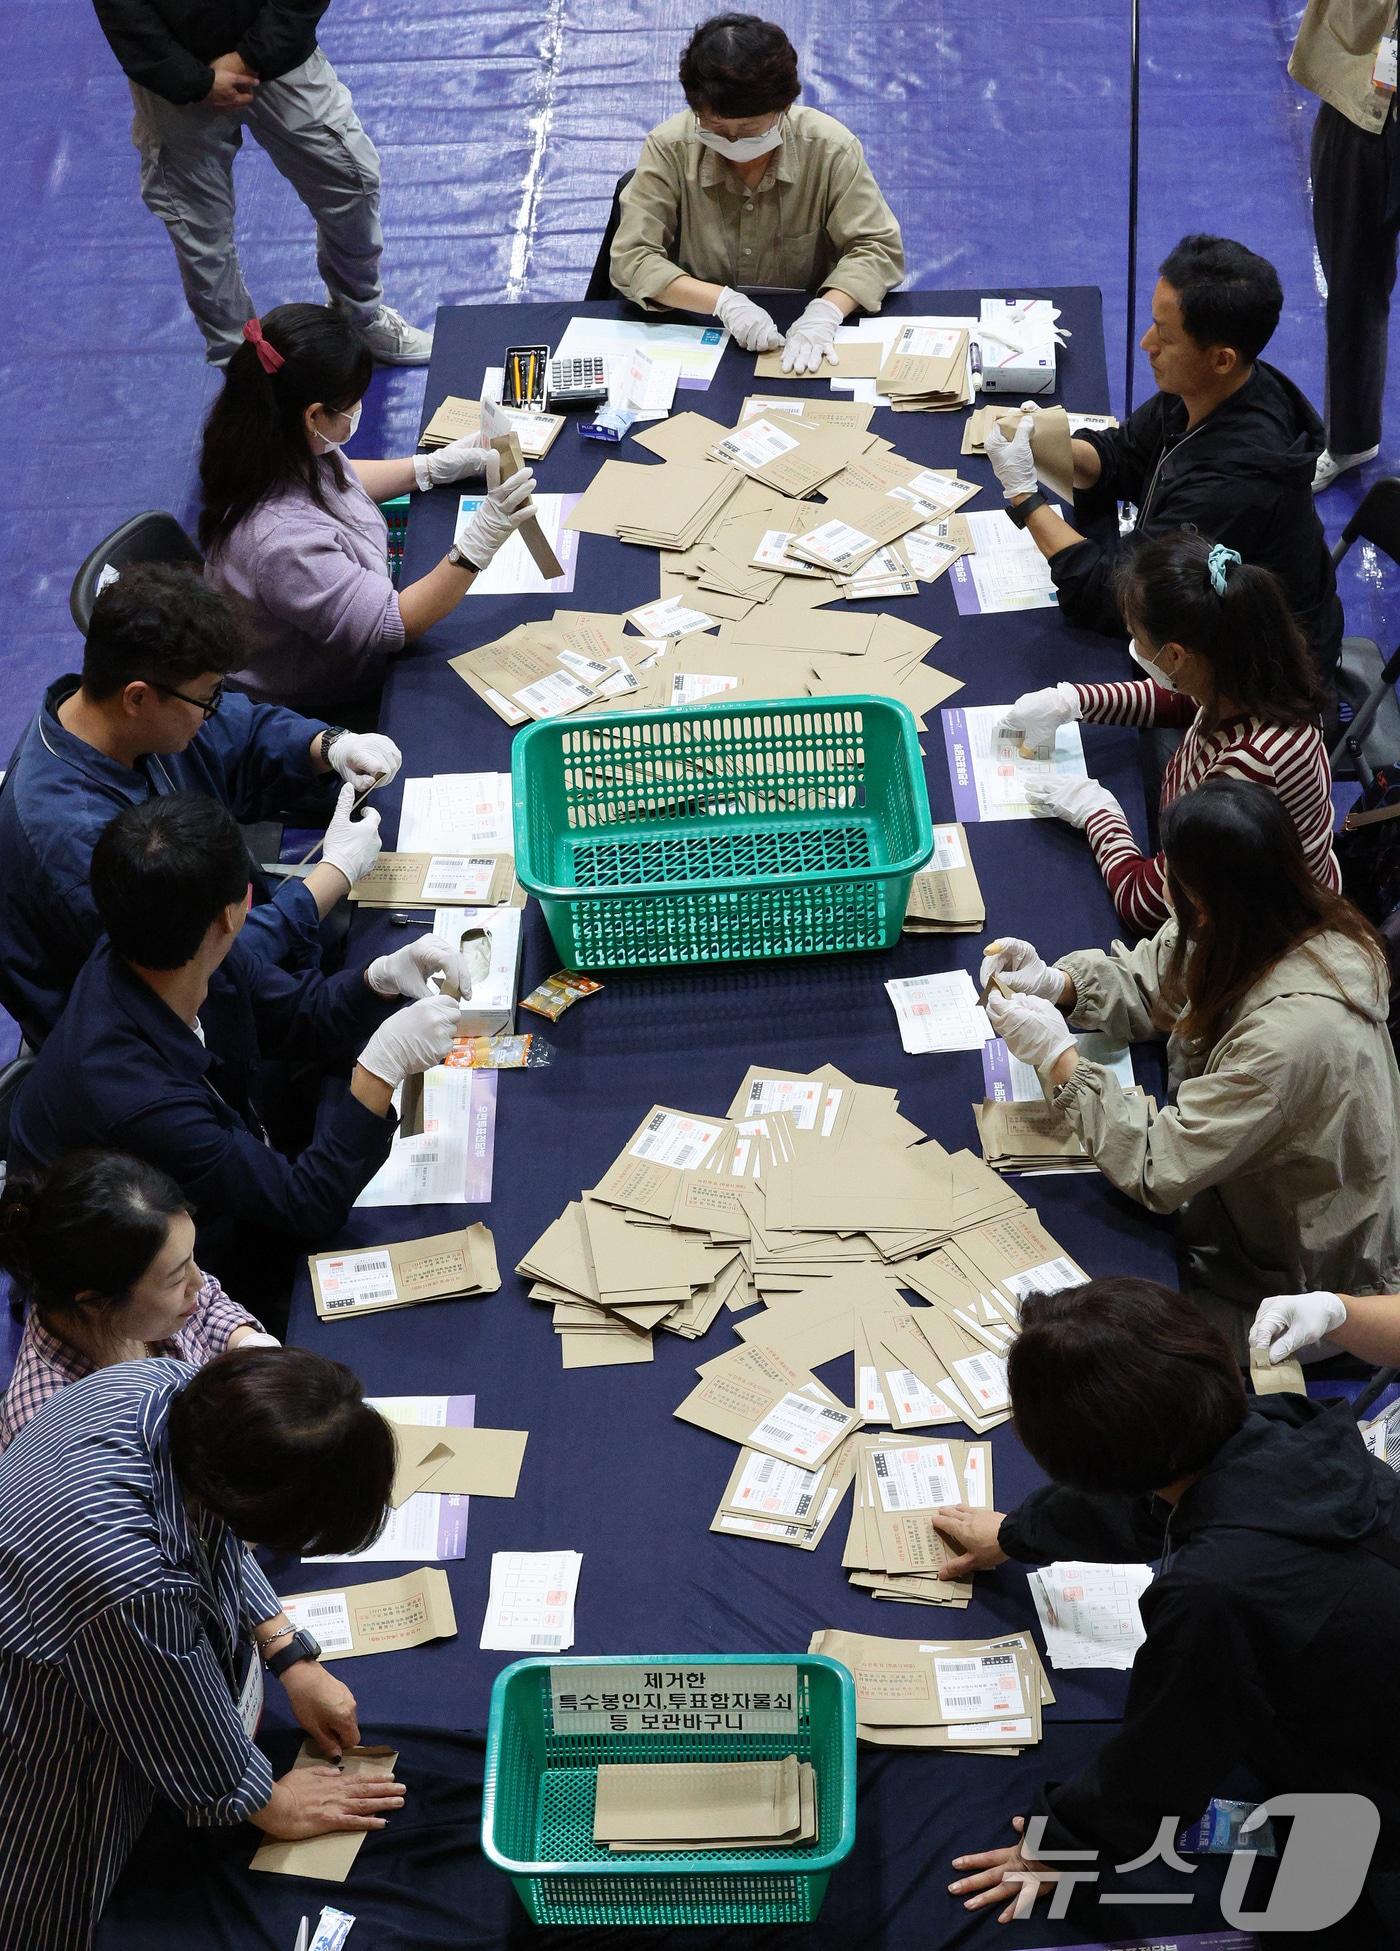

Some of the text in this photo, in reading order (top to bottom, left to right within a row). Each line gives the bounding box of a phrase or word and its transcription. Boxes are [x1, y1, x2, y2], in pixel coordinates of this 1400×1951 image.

[643, 1671, 706, 1689] 제거한
[559, 1693, 792, 1711] 특수봉인지,투표함자물쇠
[609, 1713, 743, 1731] 등 보관바구니
